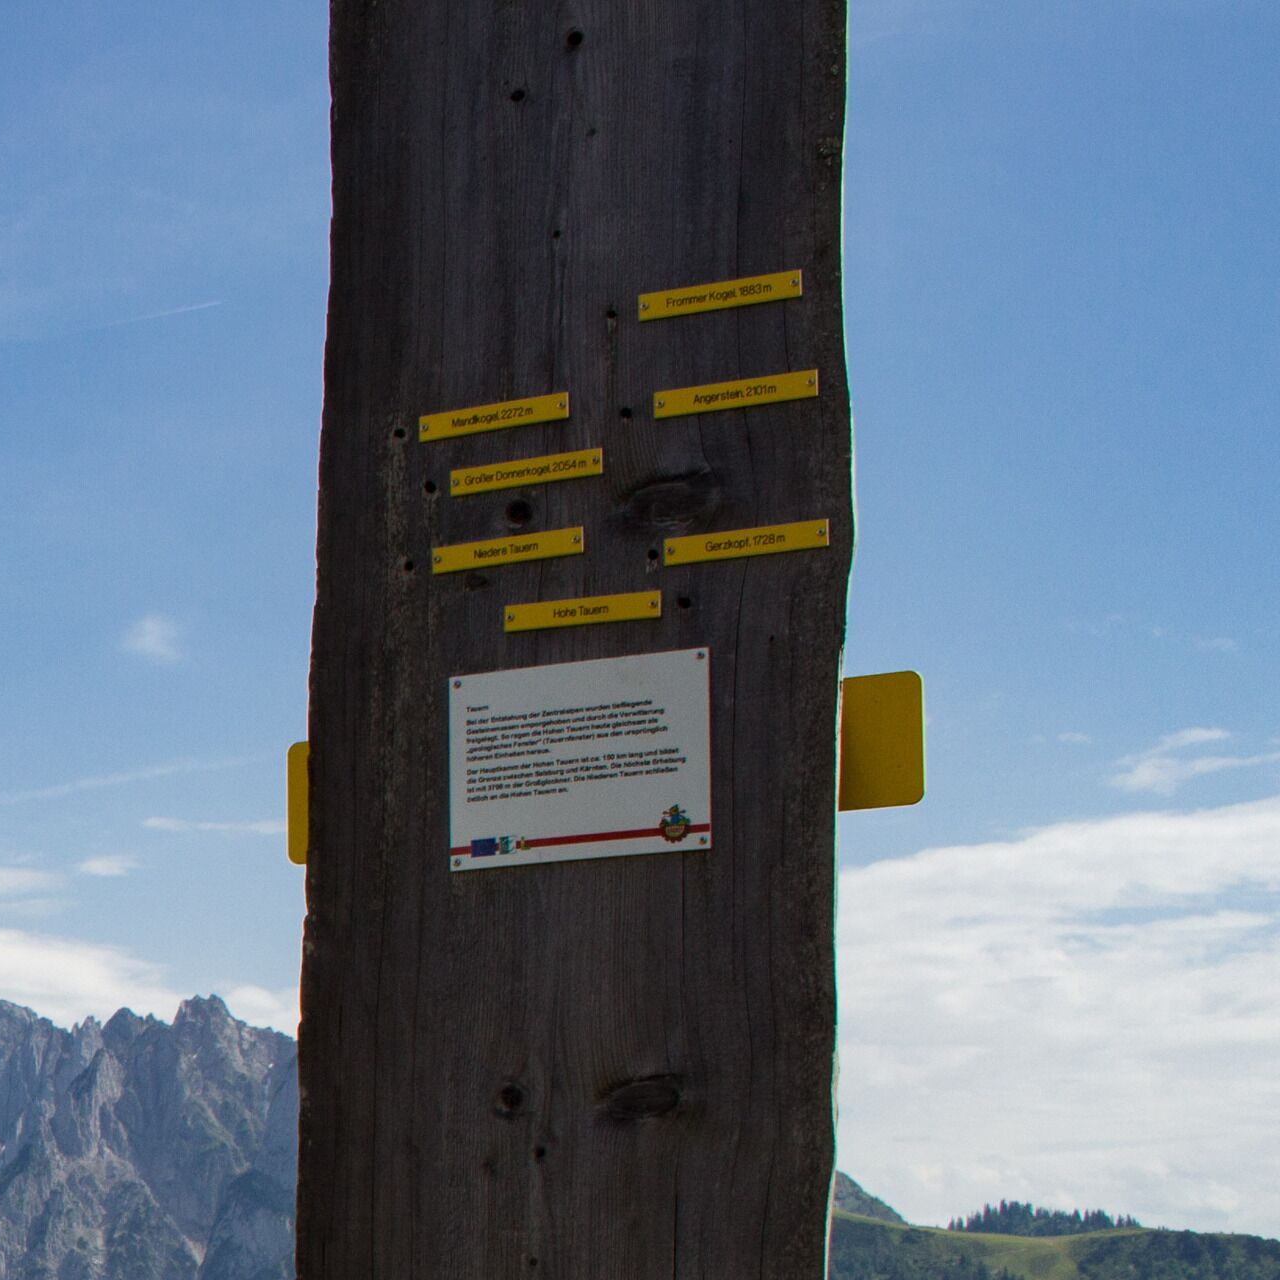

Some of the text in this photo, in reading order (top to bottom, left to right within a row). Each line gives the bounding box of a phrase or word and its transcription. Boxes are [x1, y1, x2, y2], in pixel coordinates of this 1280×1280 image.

[666, 294, 708, 308] Frommer
[739, 284, 761, 297] 1883
[746, 385, 766, 398] 2101
[767, 386, 777, 395] m
[524, 407, 534, 416] m
[464, 472, 495, 486] Großer
[577, 460, 587, 468] m
[753, 534, 775, 547] 1728
[776, 535, 786, 544] m
[474, 543, 538, 559] Niedere Tauern
[553, 605, 609, 618] Hohe Tauern
